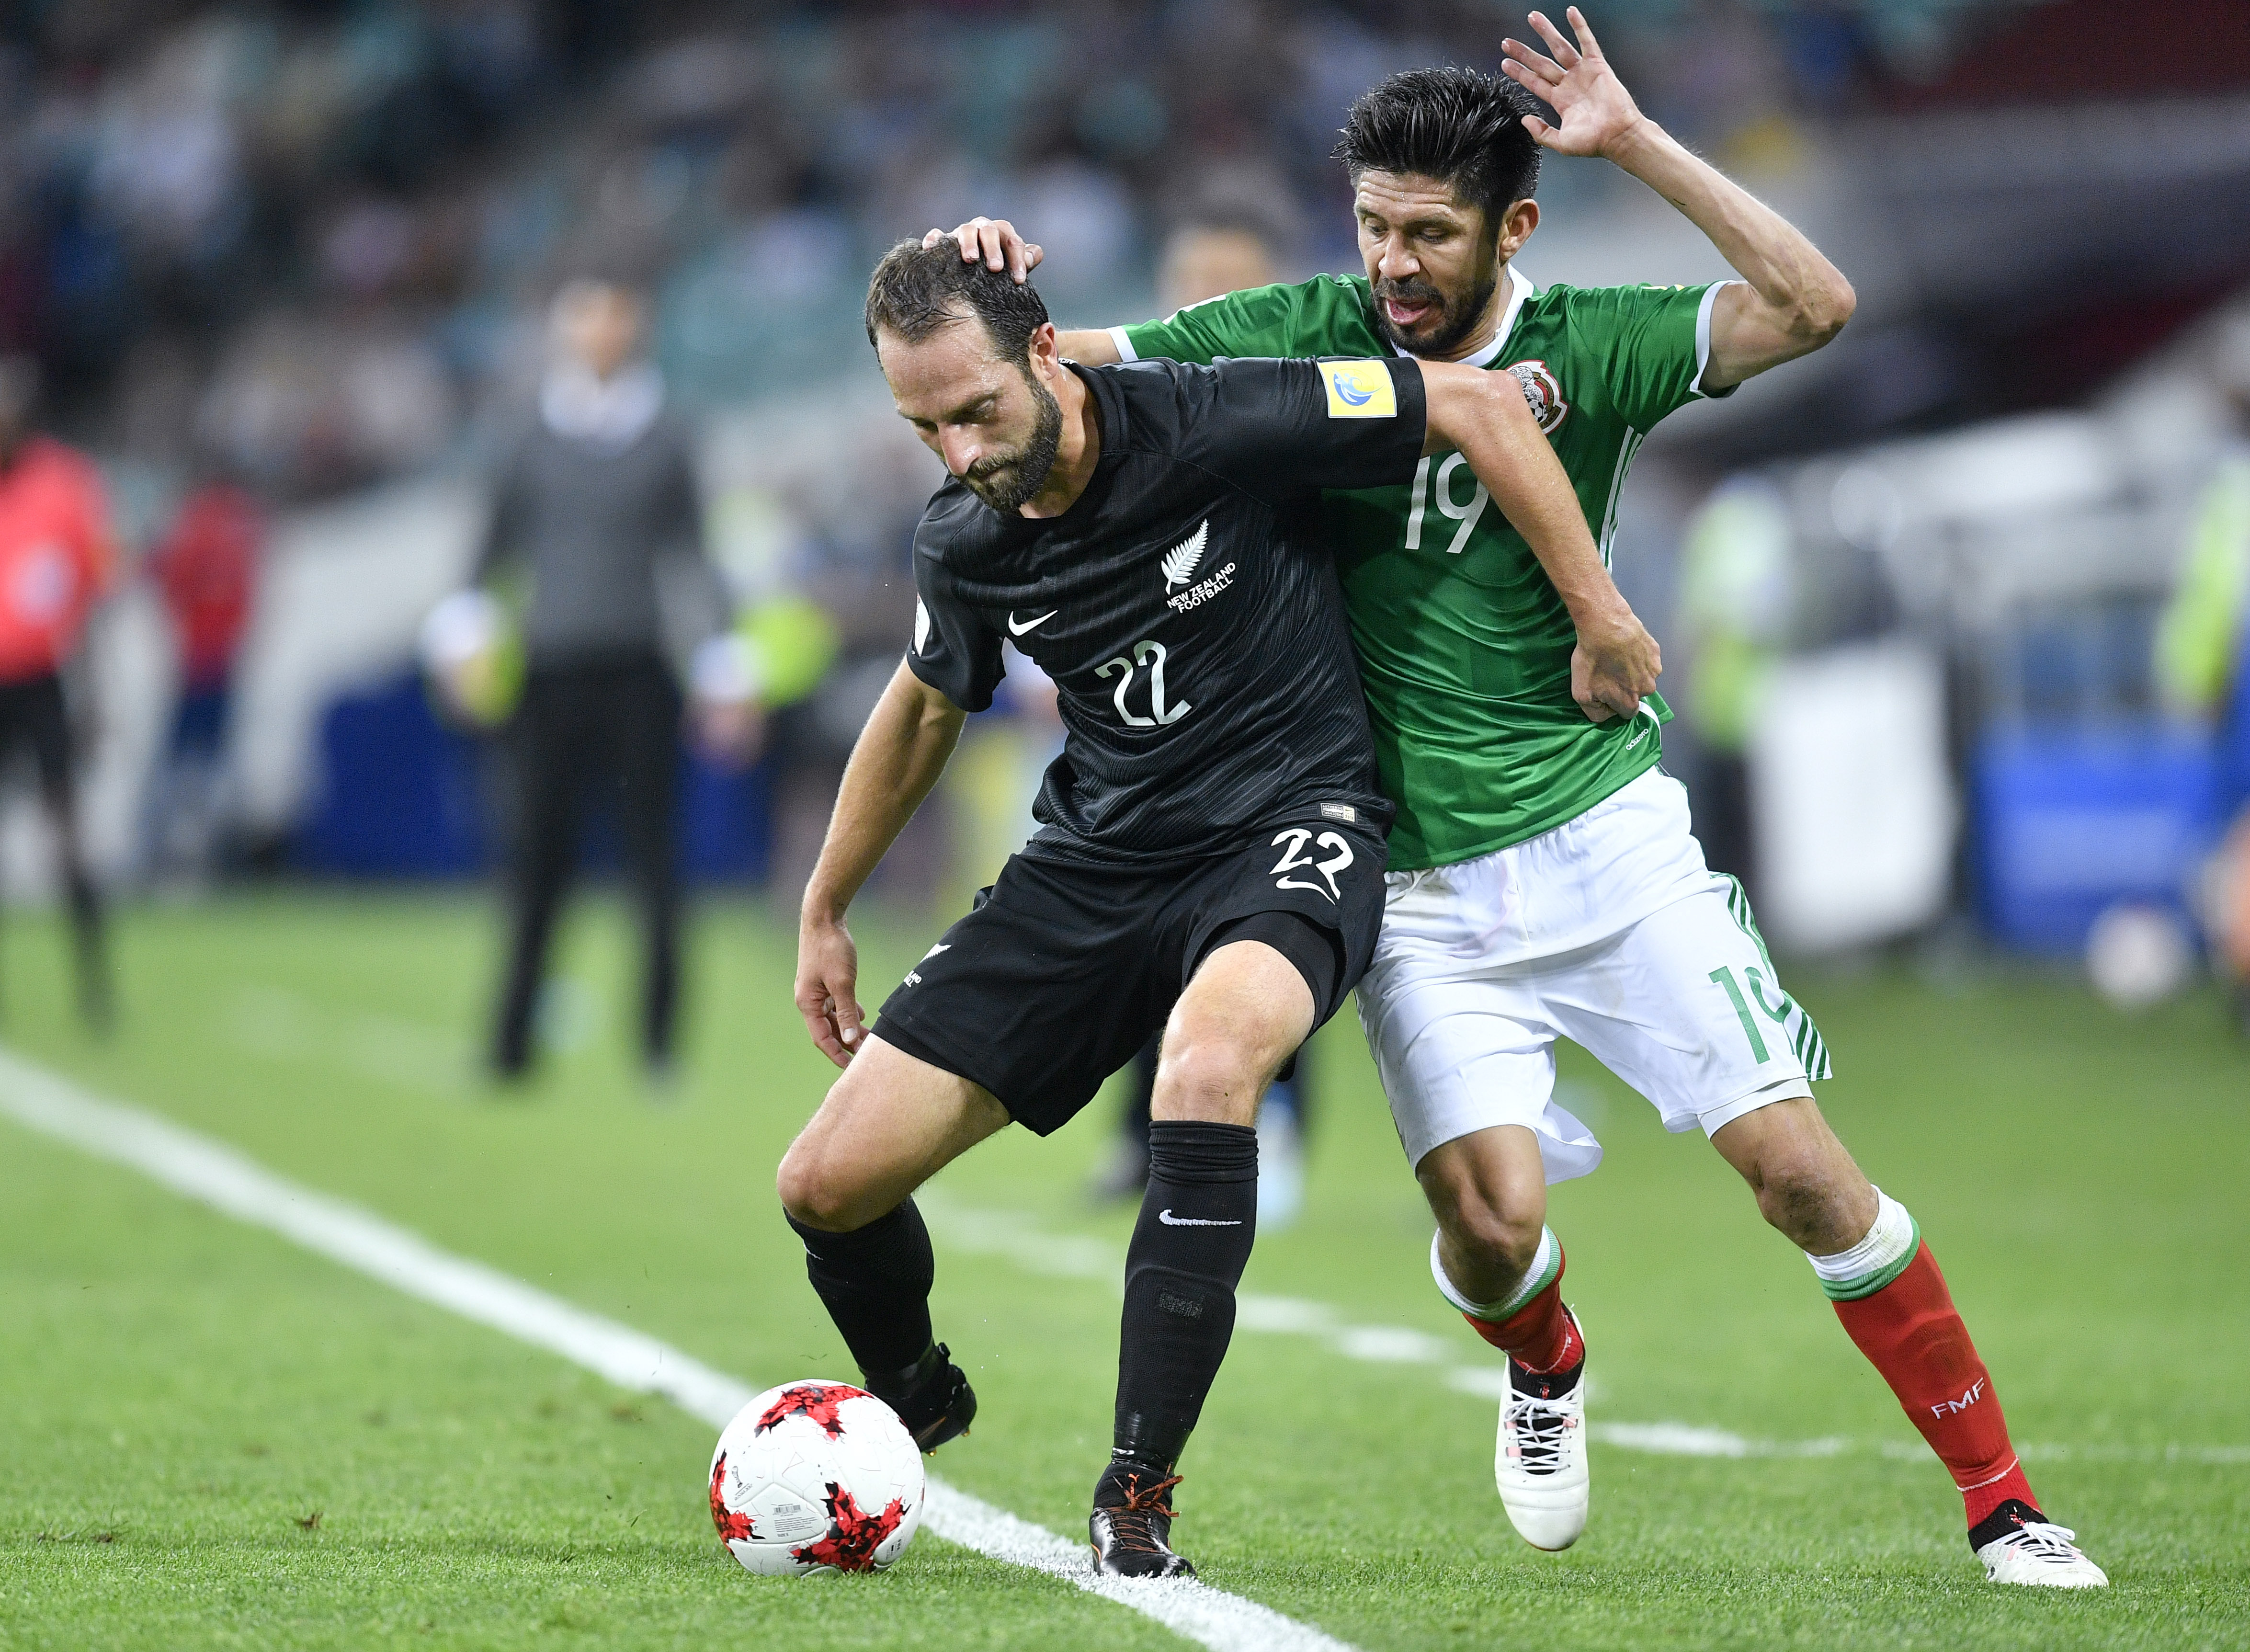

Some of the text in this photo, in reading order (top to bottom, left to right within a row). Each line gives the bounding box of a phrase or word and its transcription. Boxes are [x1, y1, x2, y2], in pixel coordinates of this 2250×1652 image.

[1405, 452, 1489, 553] 19
[1167, 562, 1236, 608] NEW ZEALAND
[1178, 577, 1233, 613] FOOTBALL
[1094, 640, 1192, 726] 22
[1626, 729, 1648, 750] adizero
[1269, 828, 1354, 900] 22
[1931, 1377, 1984, 1419] FMF
